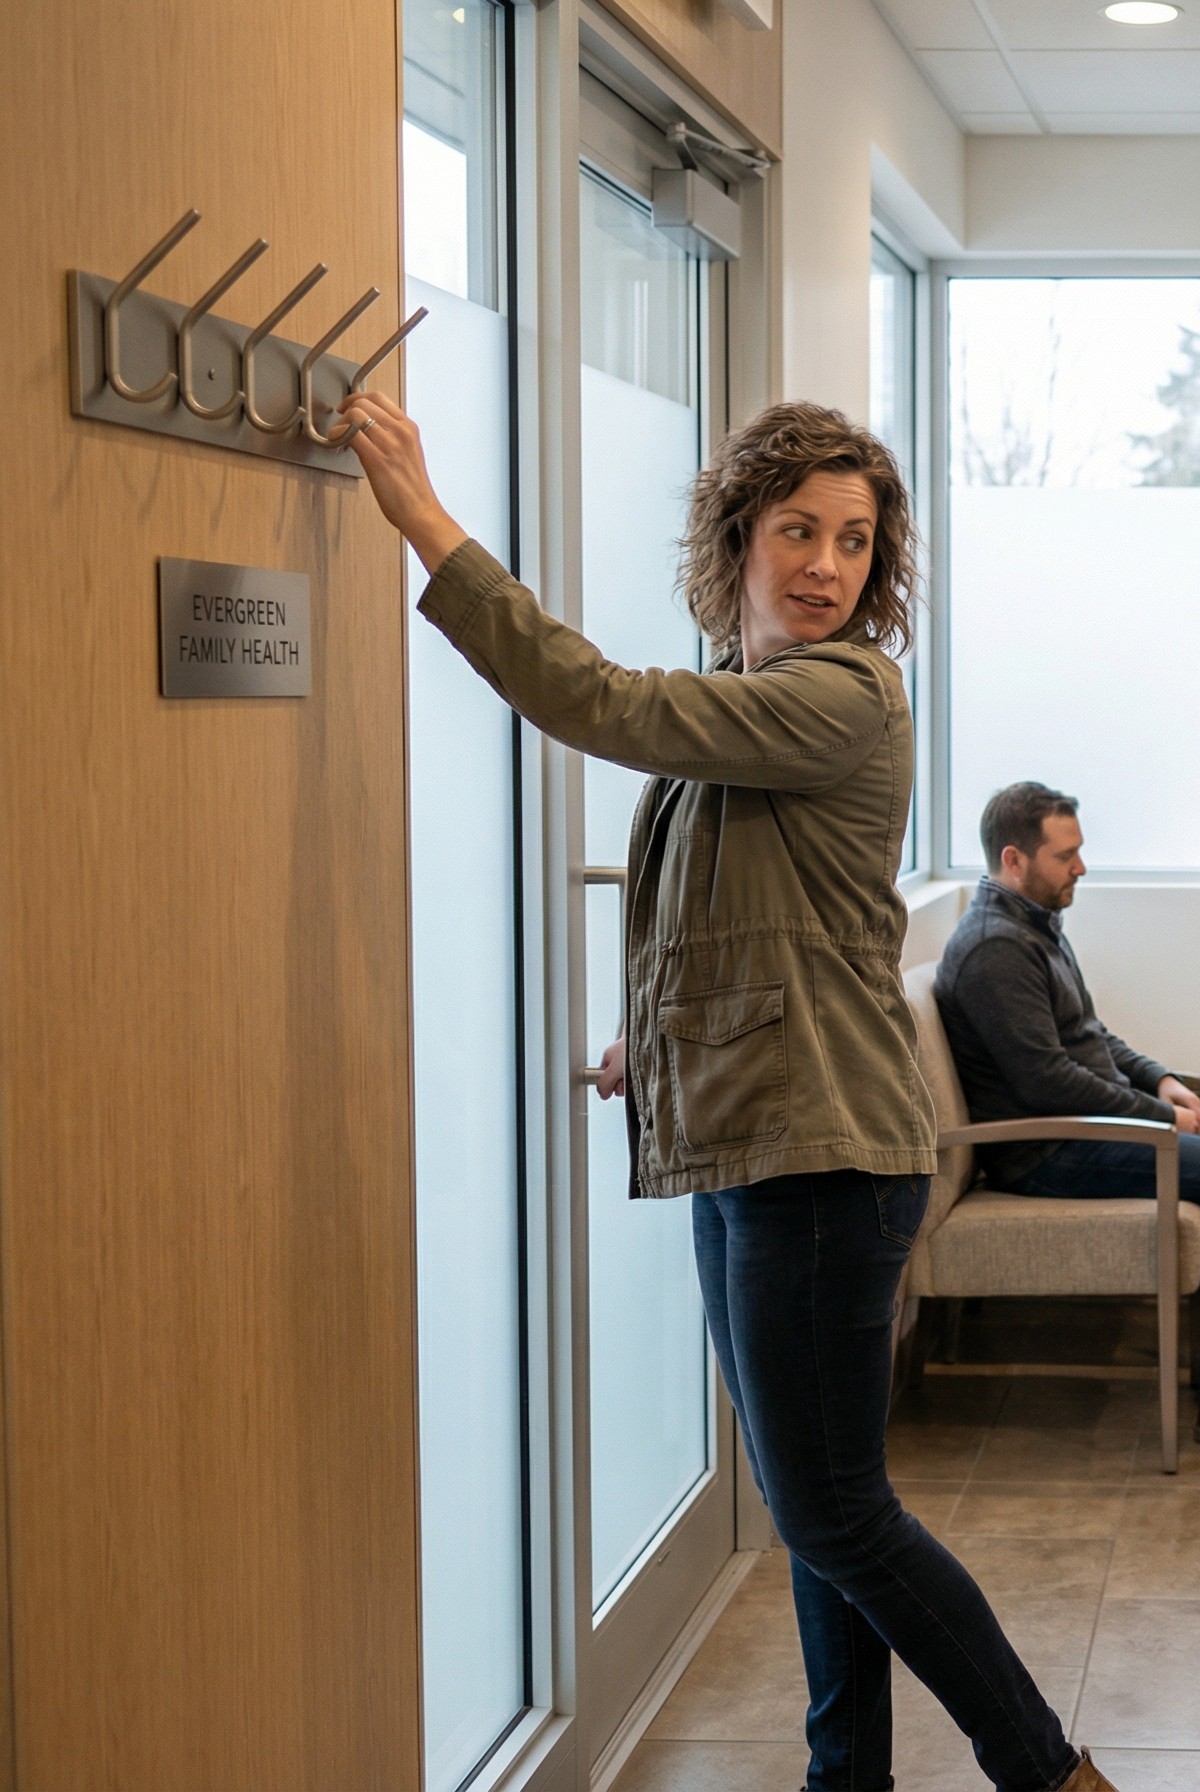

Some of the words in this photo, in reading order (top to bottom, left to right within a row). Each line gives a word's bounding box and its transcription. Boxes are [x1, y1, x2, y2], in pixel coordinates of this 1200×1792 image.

[193, 594, 286, 626] EVERGREEN
[179, 635, 236, 664] FAMILY
[242, 638, 299, 665] HEALTH
